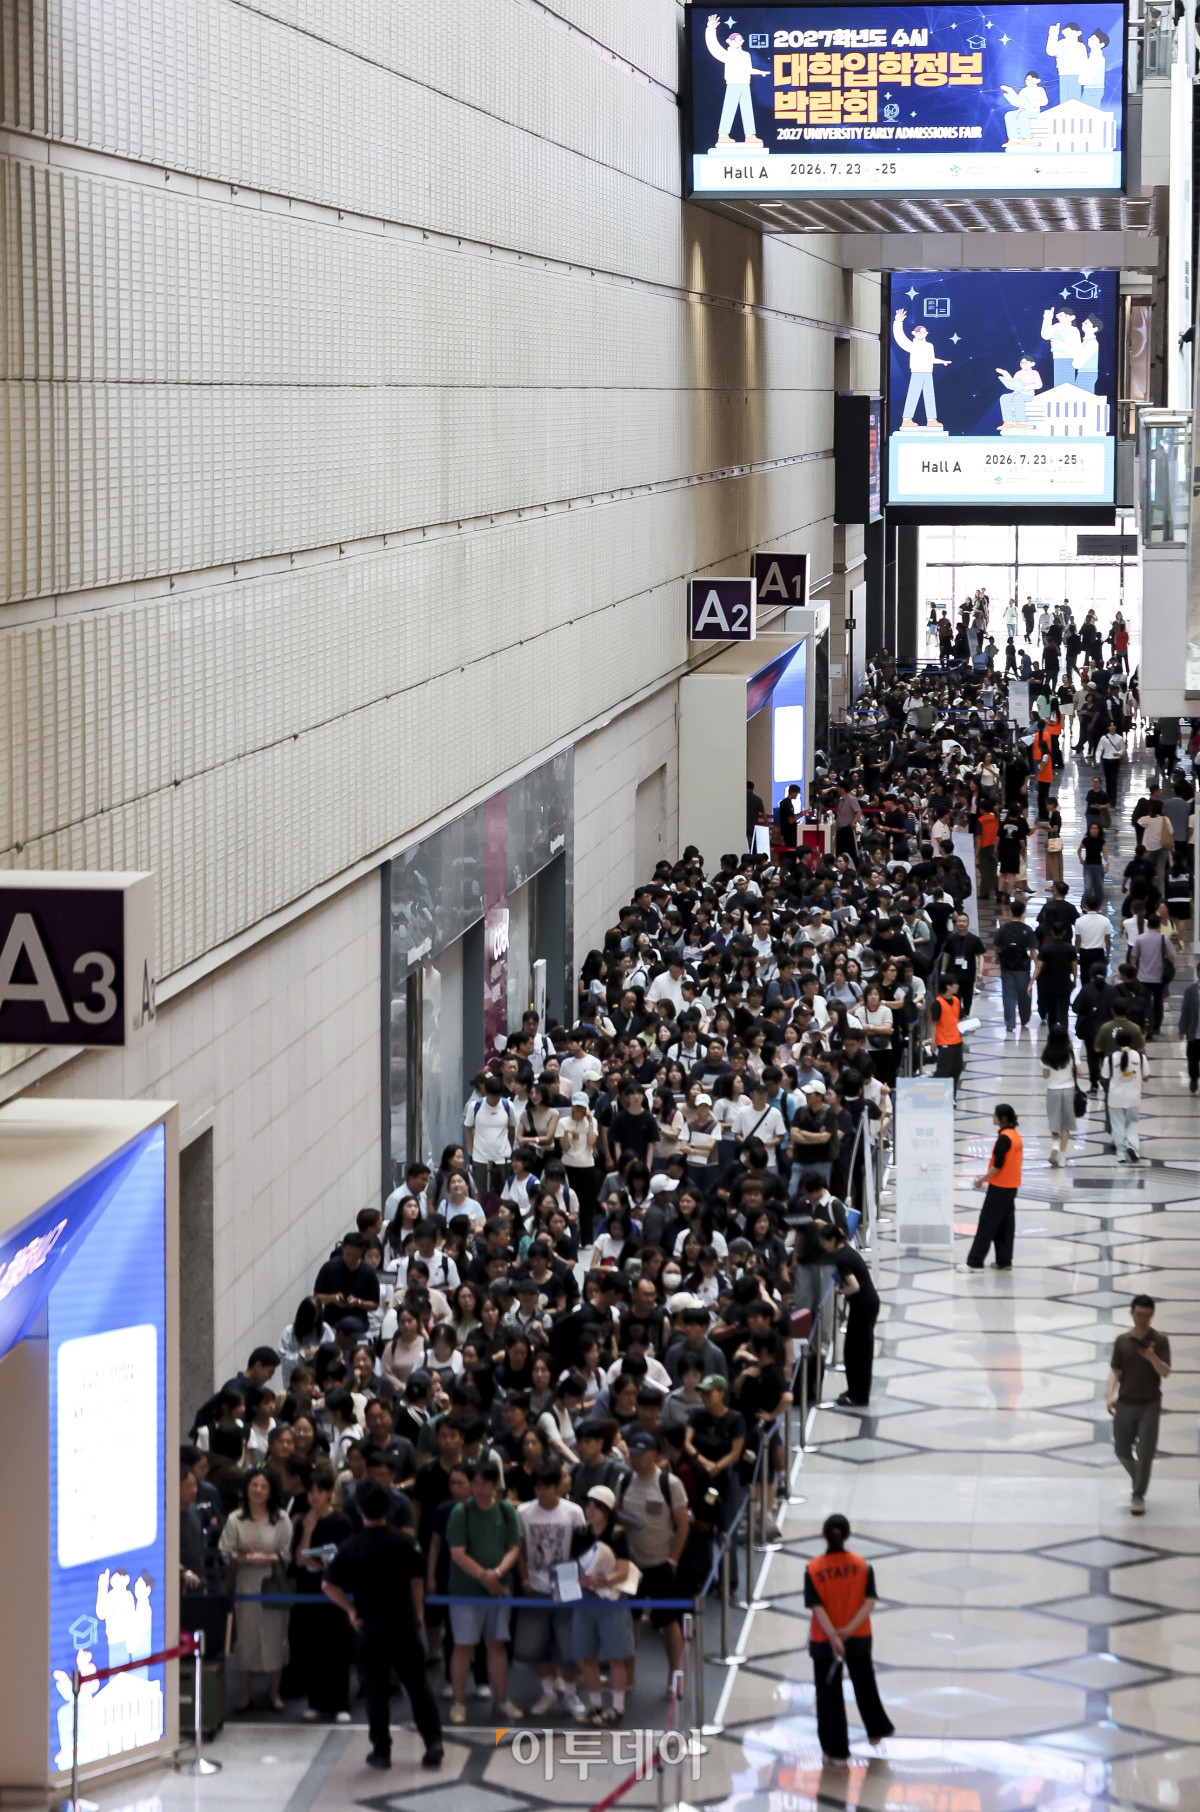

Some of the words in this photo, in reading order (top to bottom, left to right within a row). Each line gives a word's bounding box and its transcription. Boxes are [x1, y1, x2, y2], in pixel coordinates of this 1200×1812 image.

[774, 29, 887, 48] 2027학년도
[891, 28, 928, 47] 수시
[773, 51, 983, 87] 대학입학정보
[774, 89, 878, 124] 박람회
[777, 128, 802, 141] 2027
[803, 127, 863, 141] UNIVERSITY
[864, 127, 895, 140] EARLY
[895, 127, 958, 140] ADMISSIONS
[958, 126, 982, 140] FAIR
[724, 166, 754, 179] Hall
[759, 166, 769, 179] A
[922, 461, 949, 473] Hall
[952, 461, 962, 473] A
[758, 561, 801, 599] A1
[694, 589, 749, 632] A2
[0, 912, 119, 1025] A3
[816, 1565, 859, 1583] STAFF
